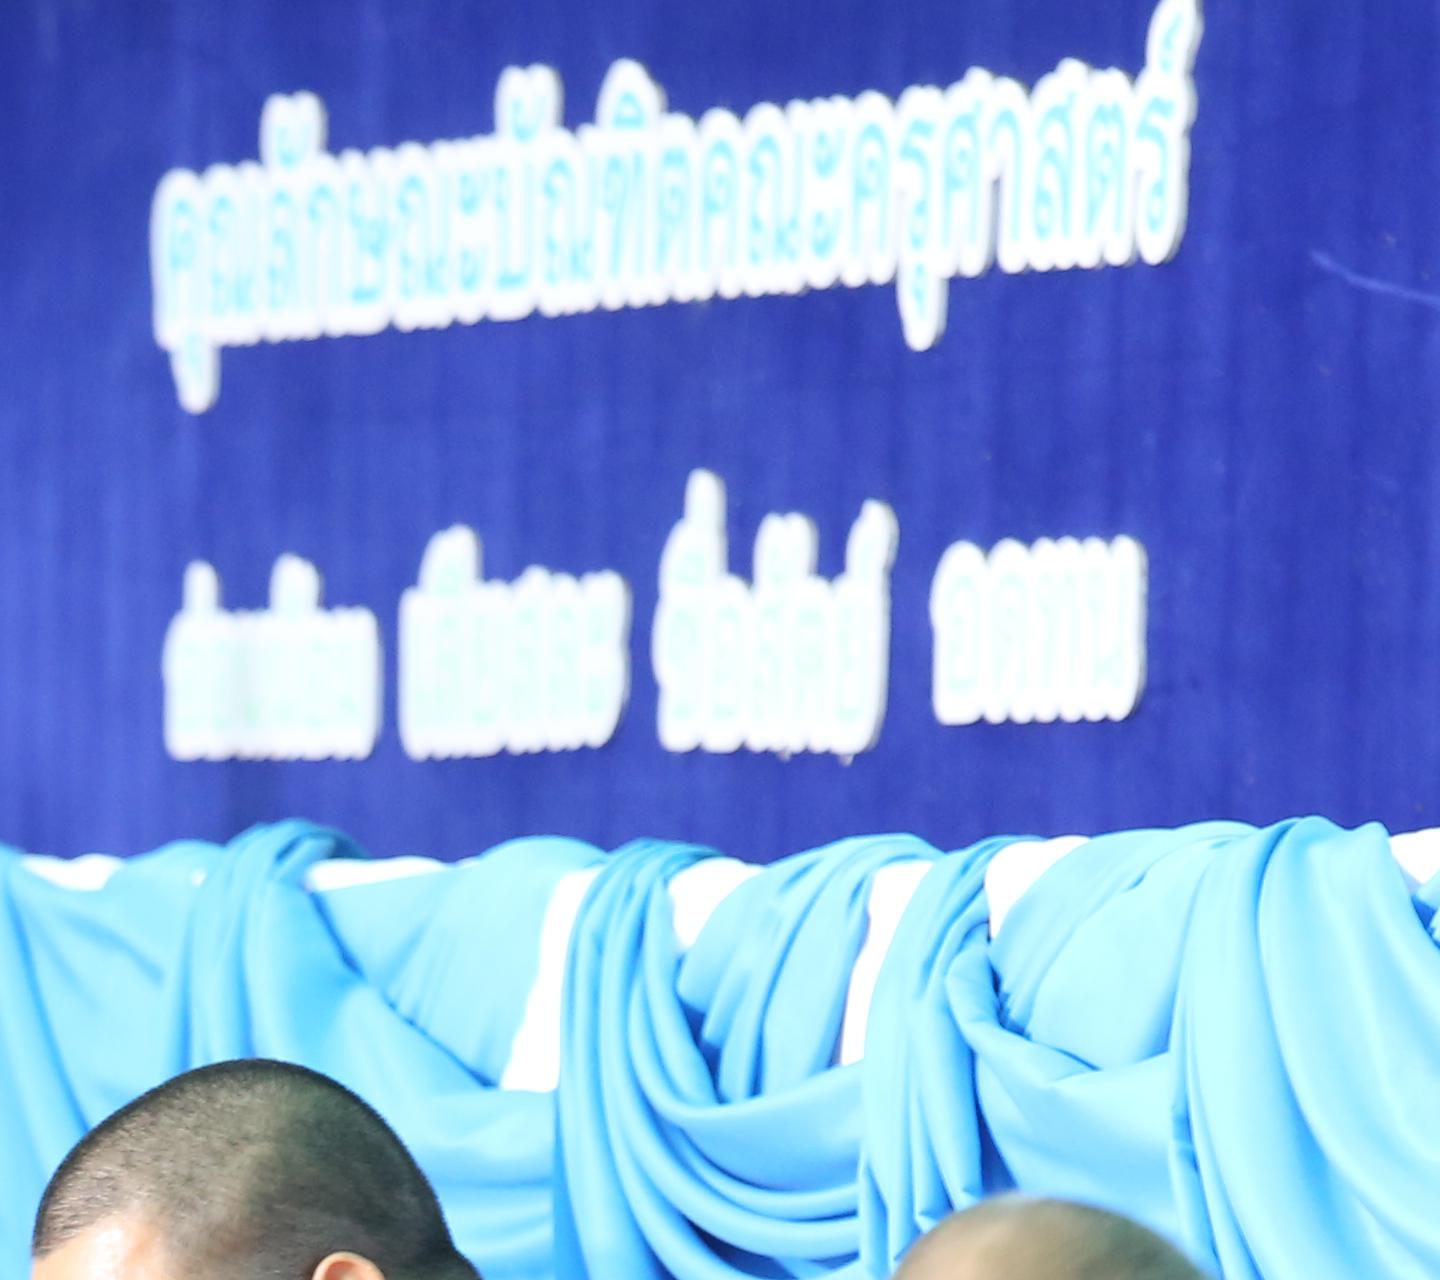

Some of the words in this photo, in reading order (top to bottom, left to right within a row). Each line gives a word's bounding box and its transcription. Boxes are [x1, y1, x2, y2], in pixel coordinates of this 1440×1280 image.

[154, 0, 1202, 412] คุณลักษณะบัณฑิตคณะครุศาสตร์
